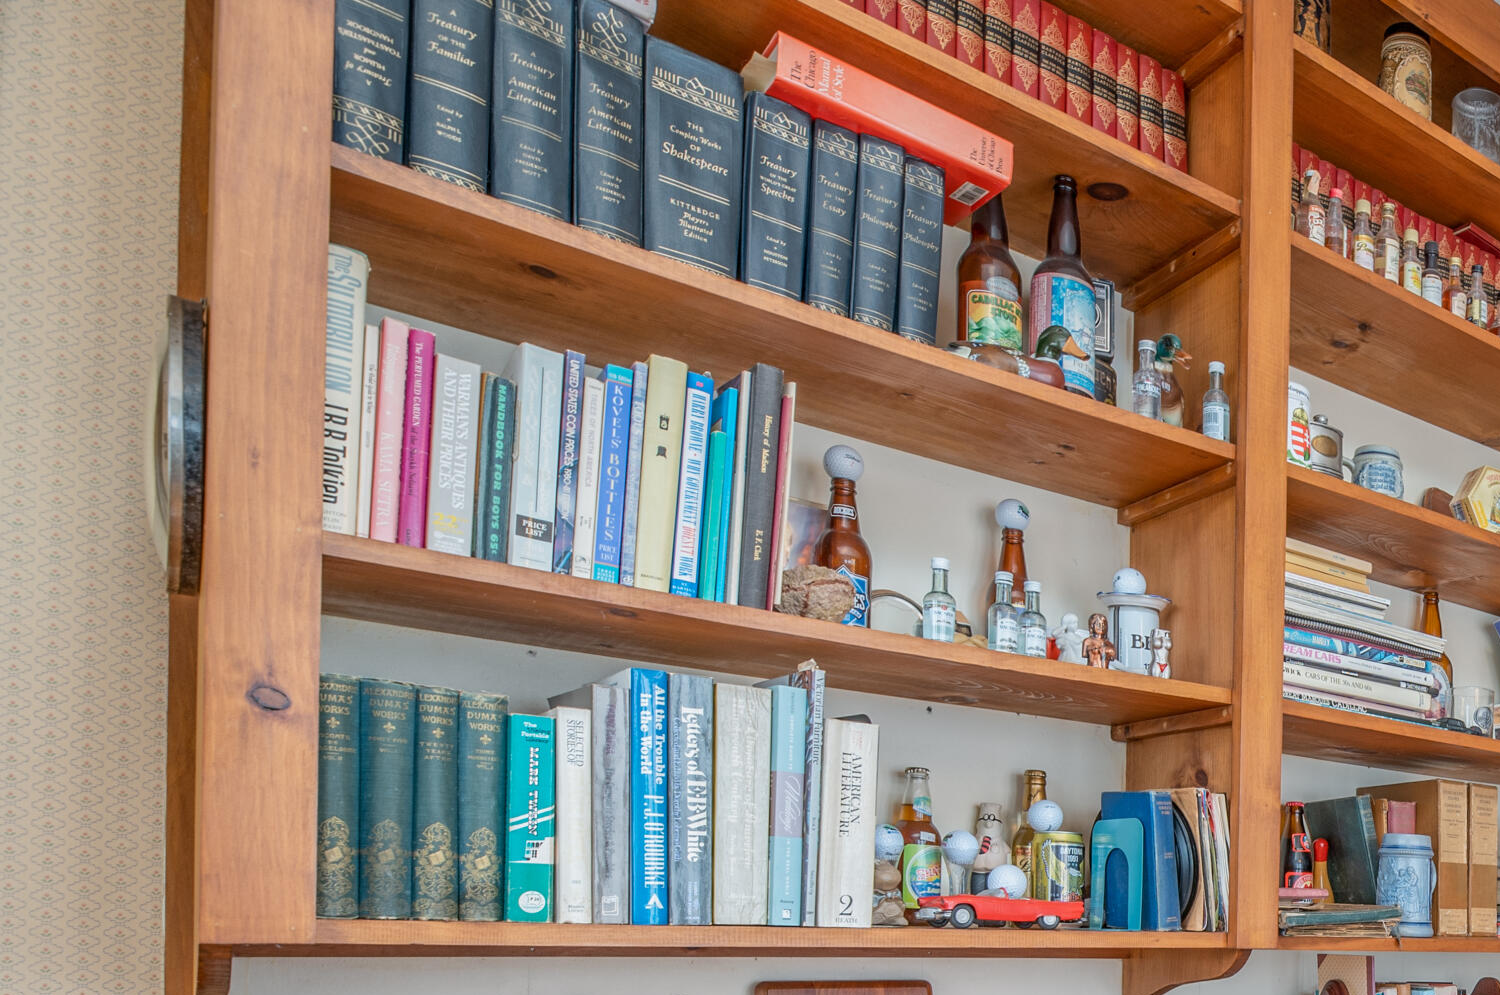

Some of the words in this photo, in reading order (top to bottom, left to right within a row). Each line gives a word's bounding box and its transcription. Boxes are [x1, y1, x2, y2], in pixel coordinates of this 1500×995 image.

[427, 12, 478, 40] Treasury
[427, 41, 476, 67] Familiar
[510, 52, 555, 79] Treasury
[790, 60, 801, 80] The
[804, 50, 816, 88] Chicago
[818, 57, 831, 91] Manual
[508, 76, 556, 101] American
[589, 83, 631, 109] Treasury
[507, 89, 557, 115] Literature
[587, 118, 633, 144] Literature
[588, 106, 632, 130] American
[686, 121, 703, 133] THE
[669, 125, 699, 142] Complete
[700, 136, 722, 151] Works
[690, 144, 701, 152] OF
[662, 141, 729, 177] Shakespeare
[760, 155, 798, 178] Treasury
[761, 183, 795, 203] Speeches
[818, 175, 853, 195] Treasury
[670, 198, 720, 220] KITTREDGE
[822, 201, 846, 216] Essay
[864, 189, 899, 208] Treasury
[861, 212, 899, 233] Philosophy
[907, 208, 938, 228] Treasury
[683, 230, 708, 242] Edition
[903, 232, 939, 252] Philosophy
[413, 355, 423, 396] PERFUMED
[444, 368, 457, 398] AND
[569, 359, 580, 388] UNITED
[412, 397, 421, 426] GARDEN
[567, 388, 578, 414] STATES
[441, 400, 455, 440] THEIR
[495, 384, 507, 459] HANDBOOK
[566, 414, 577, 438] COIN
[380, 432, 395, 472] KAMA
[564, 438, 575, 467] PRICES
[439, 441, 453, 490] PRICES
[452, 441, 467, 510] ANTIQUES
[494, 464, 503, 490] FOR
[376, 481, 393, 526] SUTRA
[491, 496, 500, 529] BOYS
[522, 519, 547, 531] PRICE
[525, 528, 544, 537] LIST
[1284, 643, 1313, 659] REAM
[1314, 652, 1341, 664] CARS
[1305, 671, 1320, 679] CARS
[641, 693, 651, 707] in
[656, 685, 665, 706] All
[814, 677, 824, 720] Victorian
[419, 704, 456, 715] DUMAS
[422, 715, 453, 725] WORKS
[467, 711, 502, 722] DUMAS
[641, 711, 651, 732] the
[656, 709, 665, 730] the
[469, 722, 500, 732] WORKS
[521, 731, 549, 739] Portable
[567, 720, 576, 753] STORIES
[681, 706, 704, 757] Letters
[576, 721, 584, 767] SELECTED
[641, 736, 652, 775] World
[813, 722, 823, 764] Furniture
[529, 747, 539, 786] MARK
[567, 753, 576, 764] OF
[656, 733, 665, 785] Trouble
[687, 761, 706, 777] of
[839, 752, 851, 838] LITERATURE
[851, 753, 862, 824] AMERICAN
[528, 790, 538, 836] TWAIN
[644, 822, 664, 888] O'ROURKE
[839, 895, 853, 917] 2
